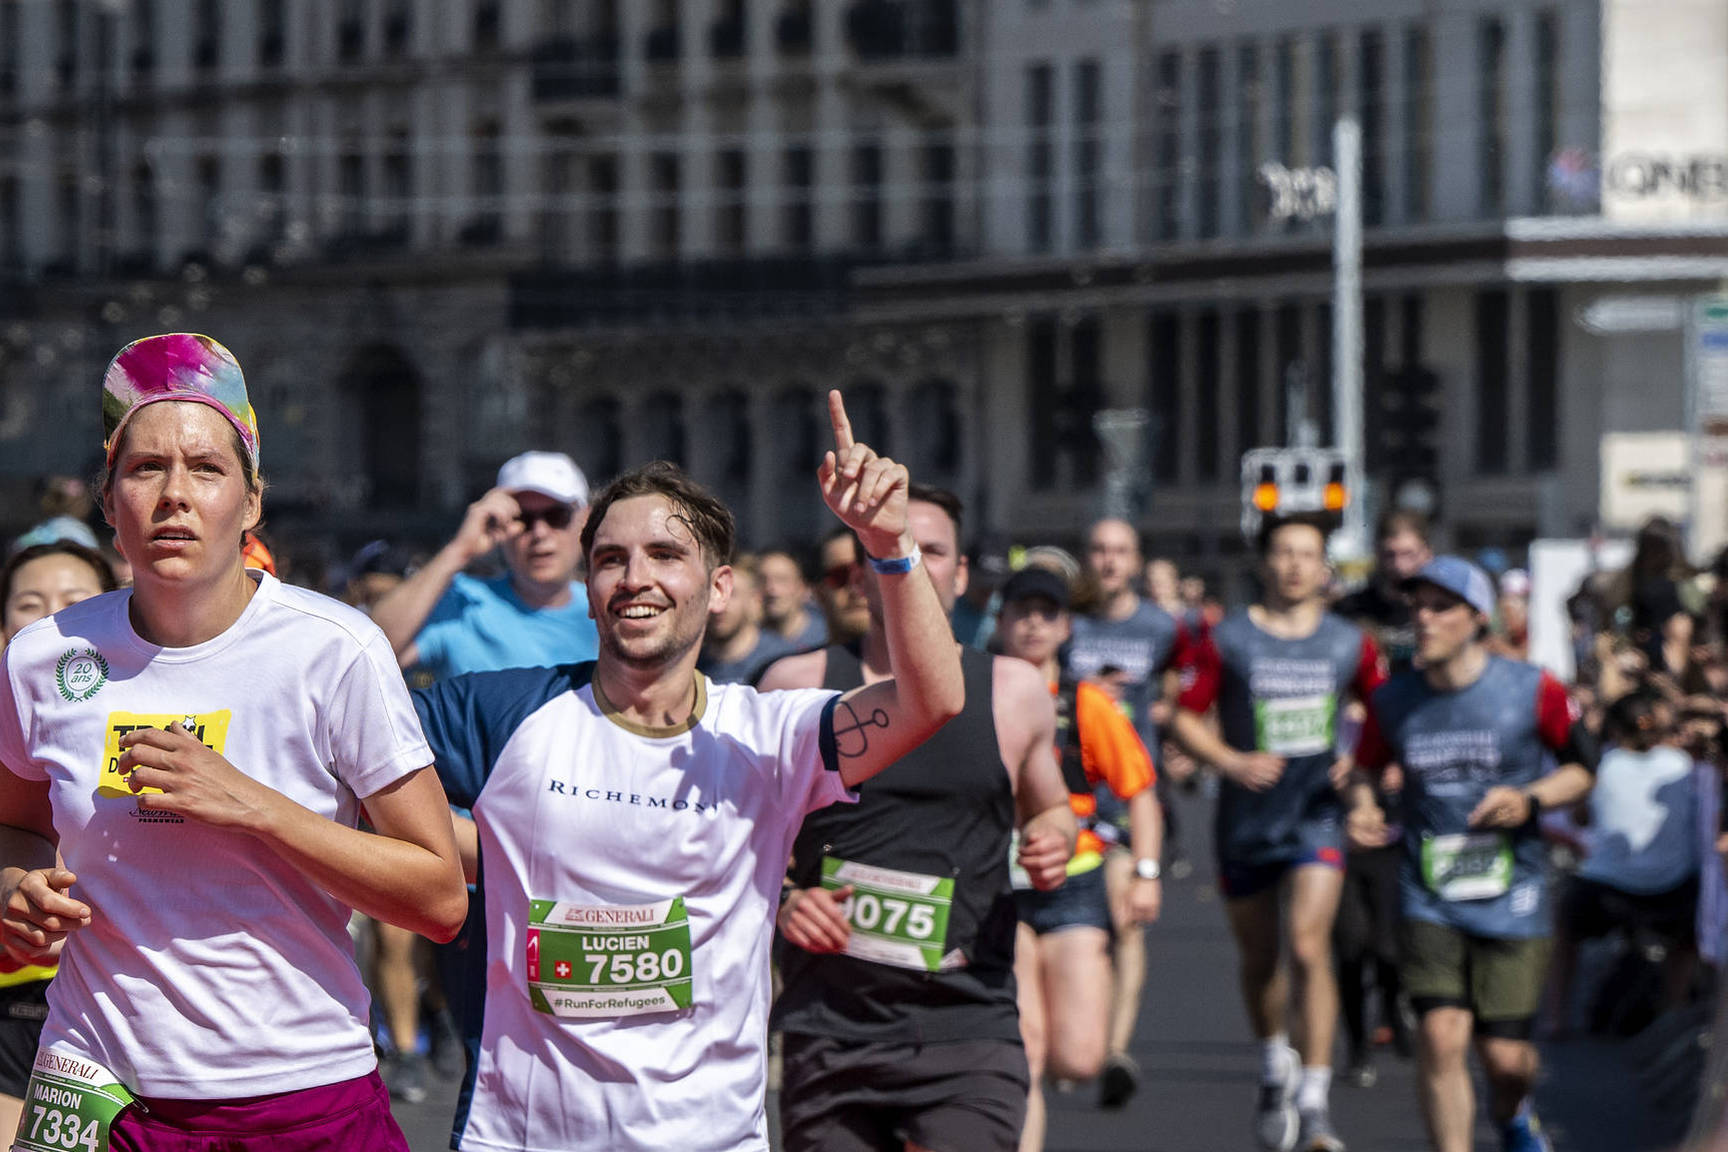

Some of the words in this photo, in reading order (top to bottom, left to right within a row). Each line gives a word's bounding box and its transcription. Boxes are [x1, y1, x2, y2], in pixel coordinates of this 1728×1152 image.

[73, 662, 92, 674] 20
[71, 674, 93, 683] ans
[585, 908, 655, 924] GENERALI
[582, 935, 651, 951] LUCIEN
[584, 948, 683, 984] 7580
[554, 996, 666, 1010] #RunForRefugees
[42, 1052, 100, 1080] GENERALI
[33, 1083, 83, 1110] MARION
